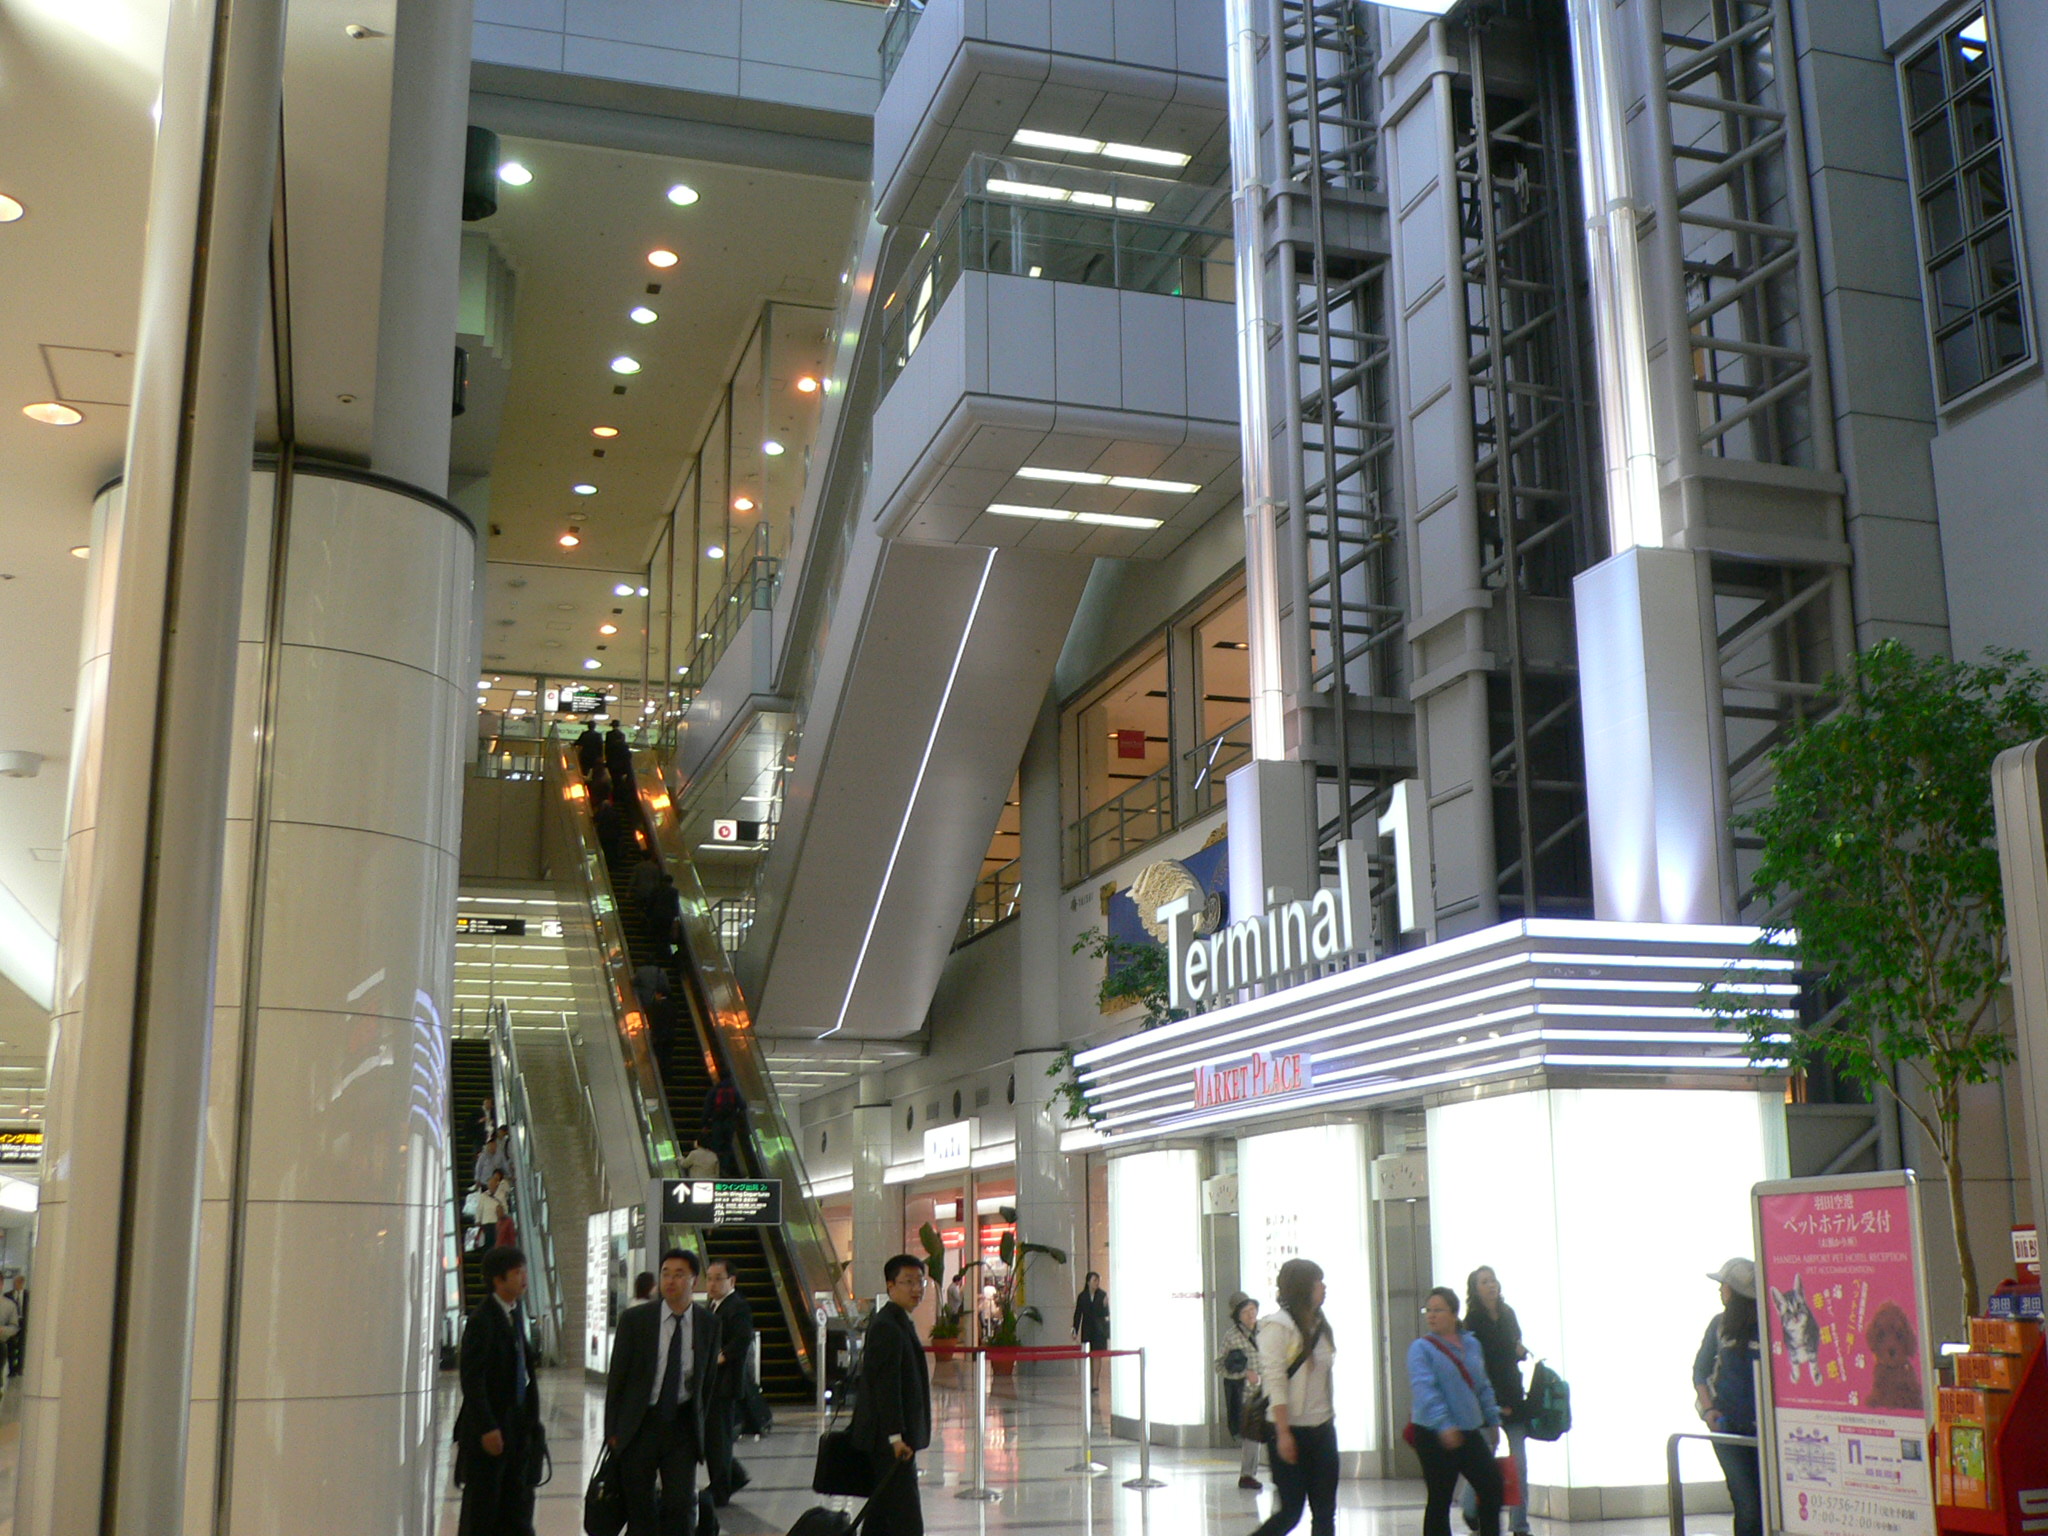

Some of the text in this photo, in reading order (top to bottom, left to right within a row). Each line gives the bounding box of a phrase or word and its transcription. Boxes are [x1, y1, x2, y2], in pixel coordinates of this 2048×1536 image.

[1157, 779, 1415, 1010] Terminal 1
[1193, 1052, 1301, 1109] MARKET PLACE
[1783, 1209, 1892, 1234] ペットホテル受付
[1814, 1194, 1854, 1211] 羽田空港
